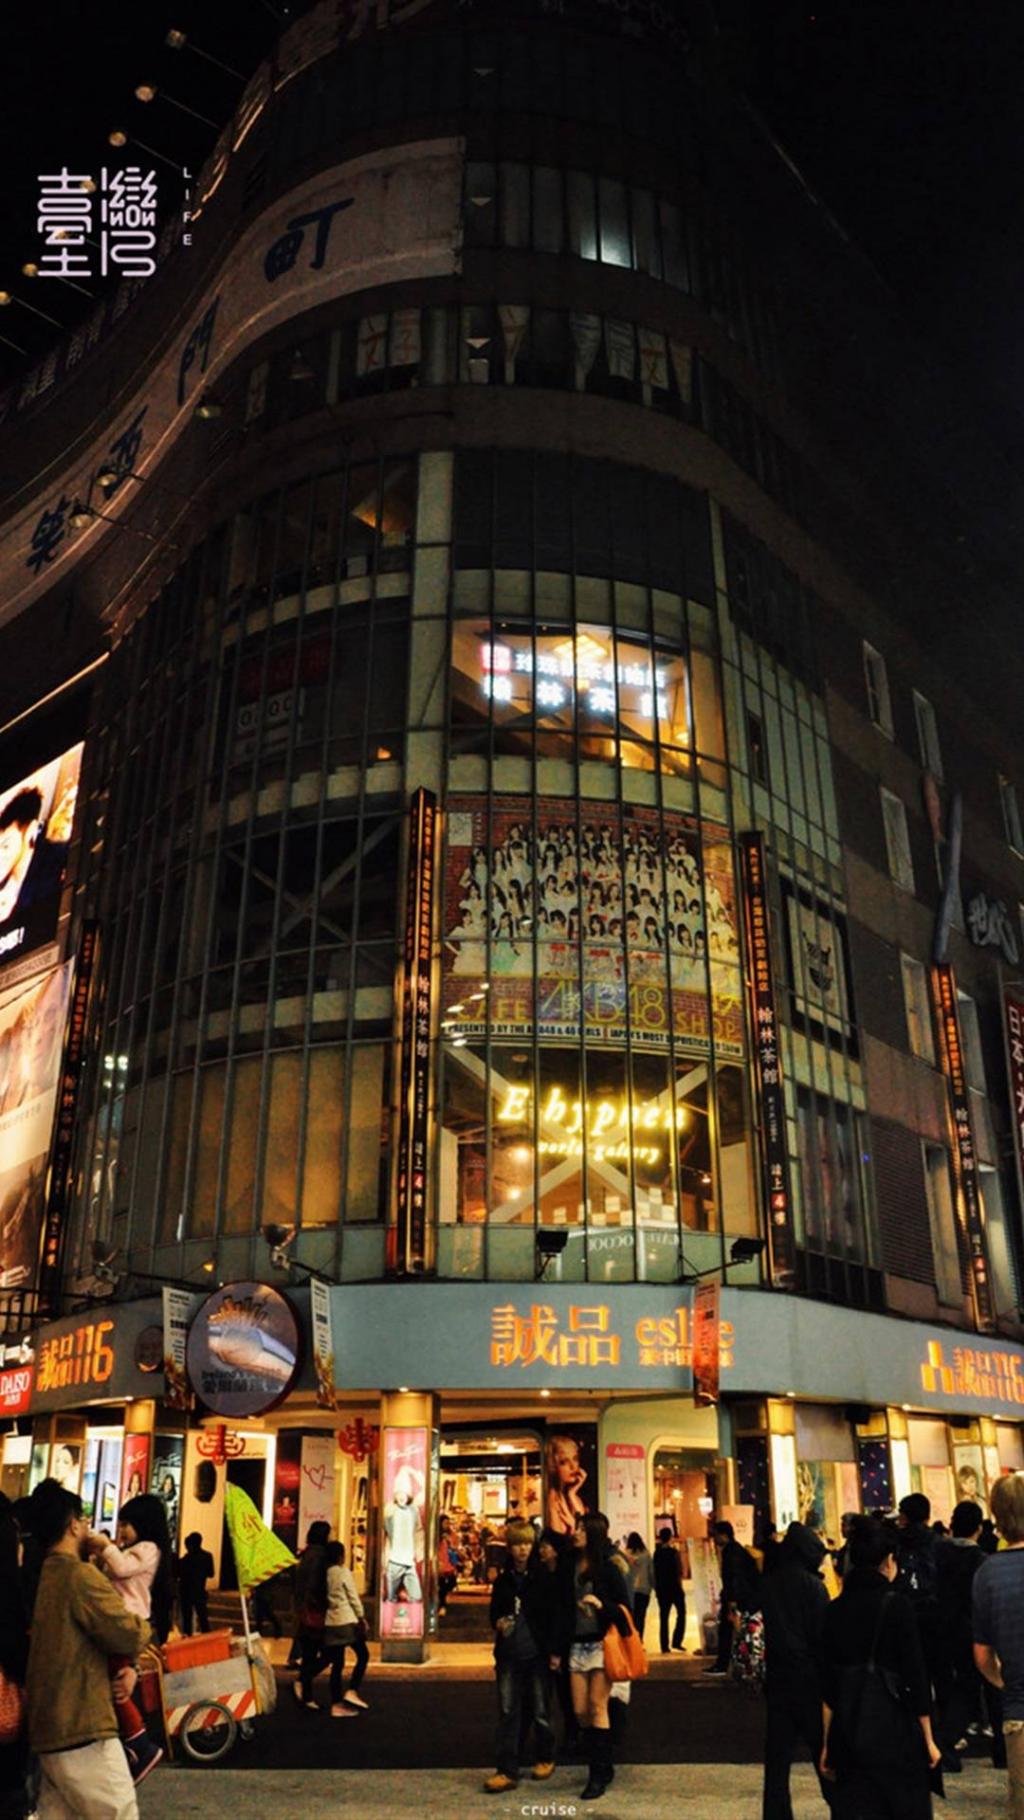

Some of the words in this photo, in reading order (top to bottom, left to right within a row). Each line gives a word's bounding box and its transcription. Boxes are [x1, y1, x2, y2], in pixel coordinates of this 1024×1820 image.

[498, 1085, 530, 1121] E
[489, 1303, 621, 1368] 誠品
[635, 1308, 735, 1348] esle
